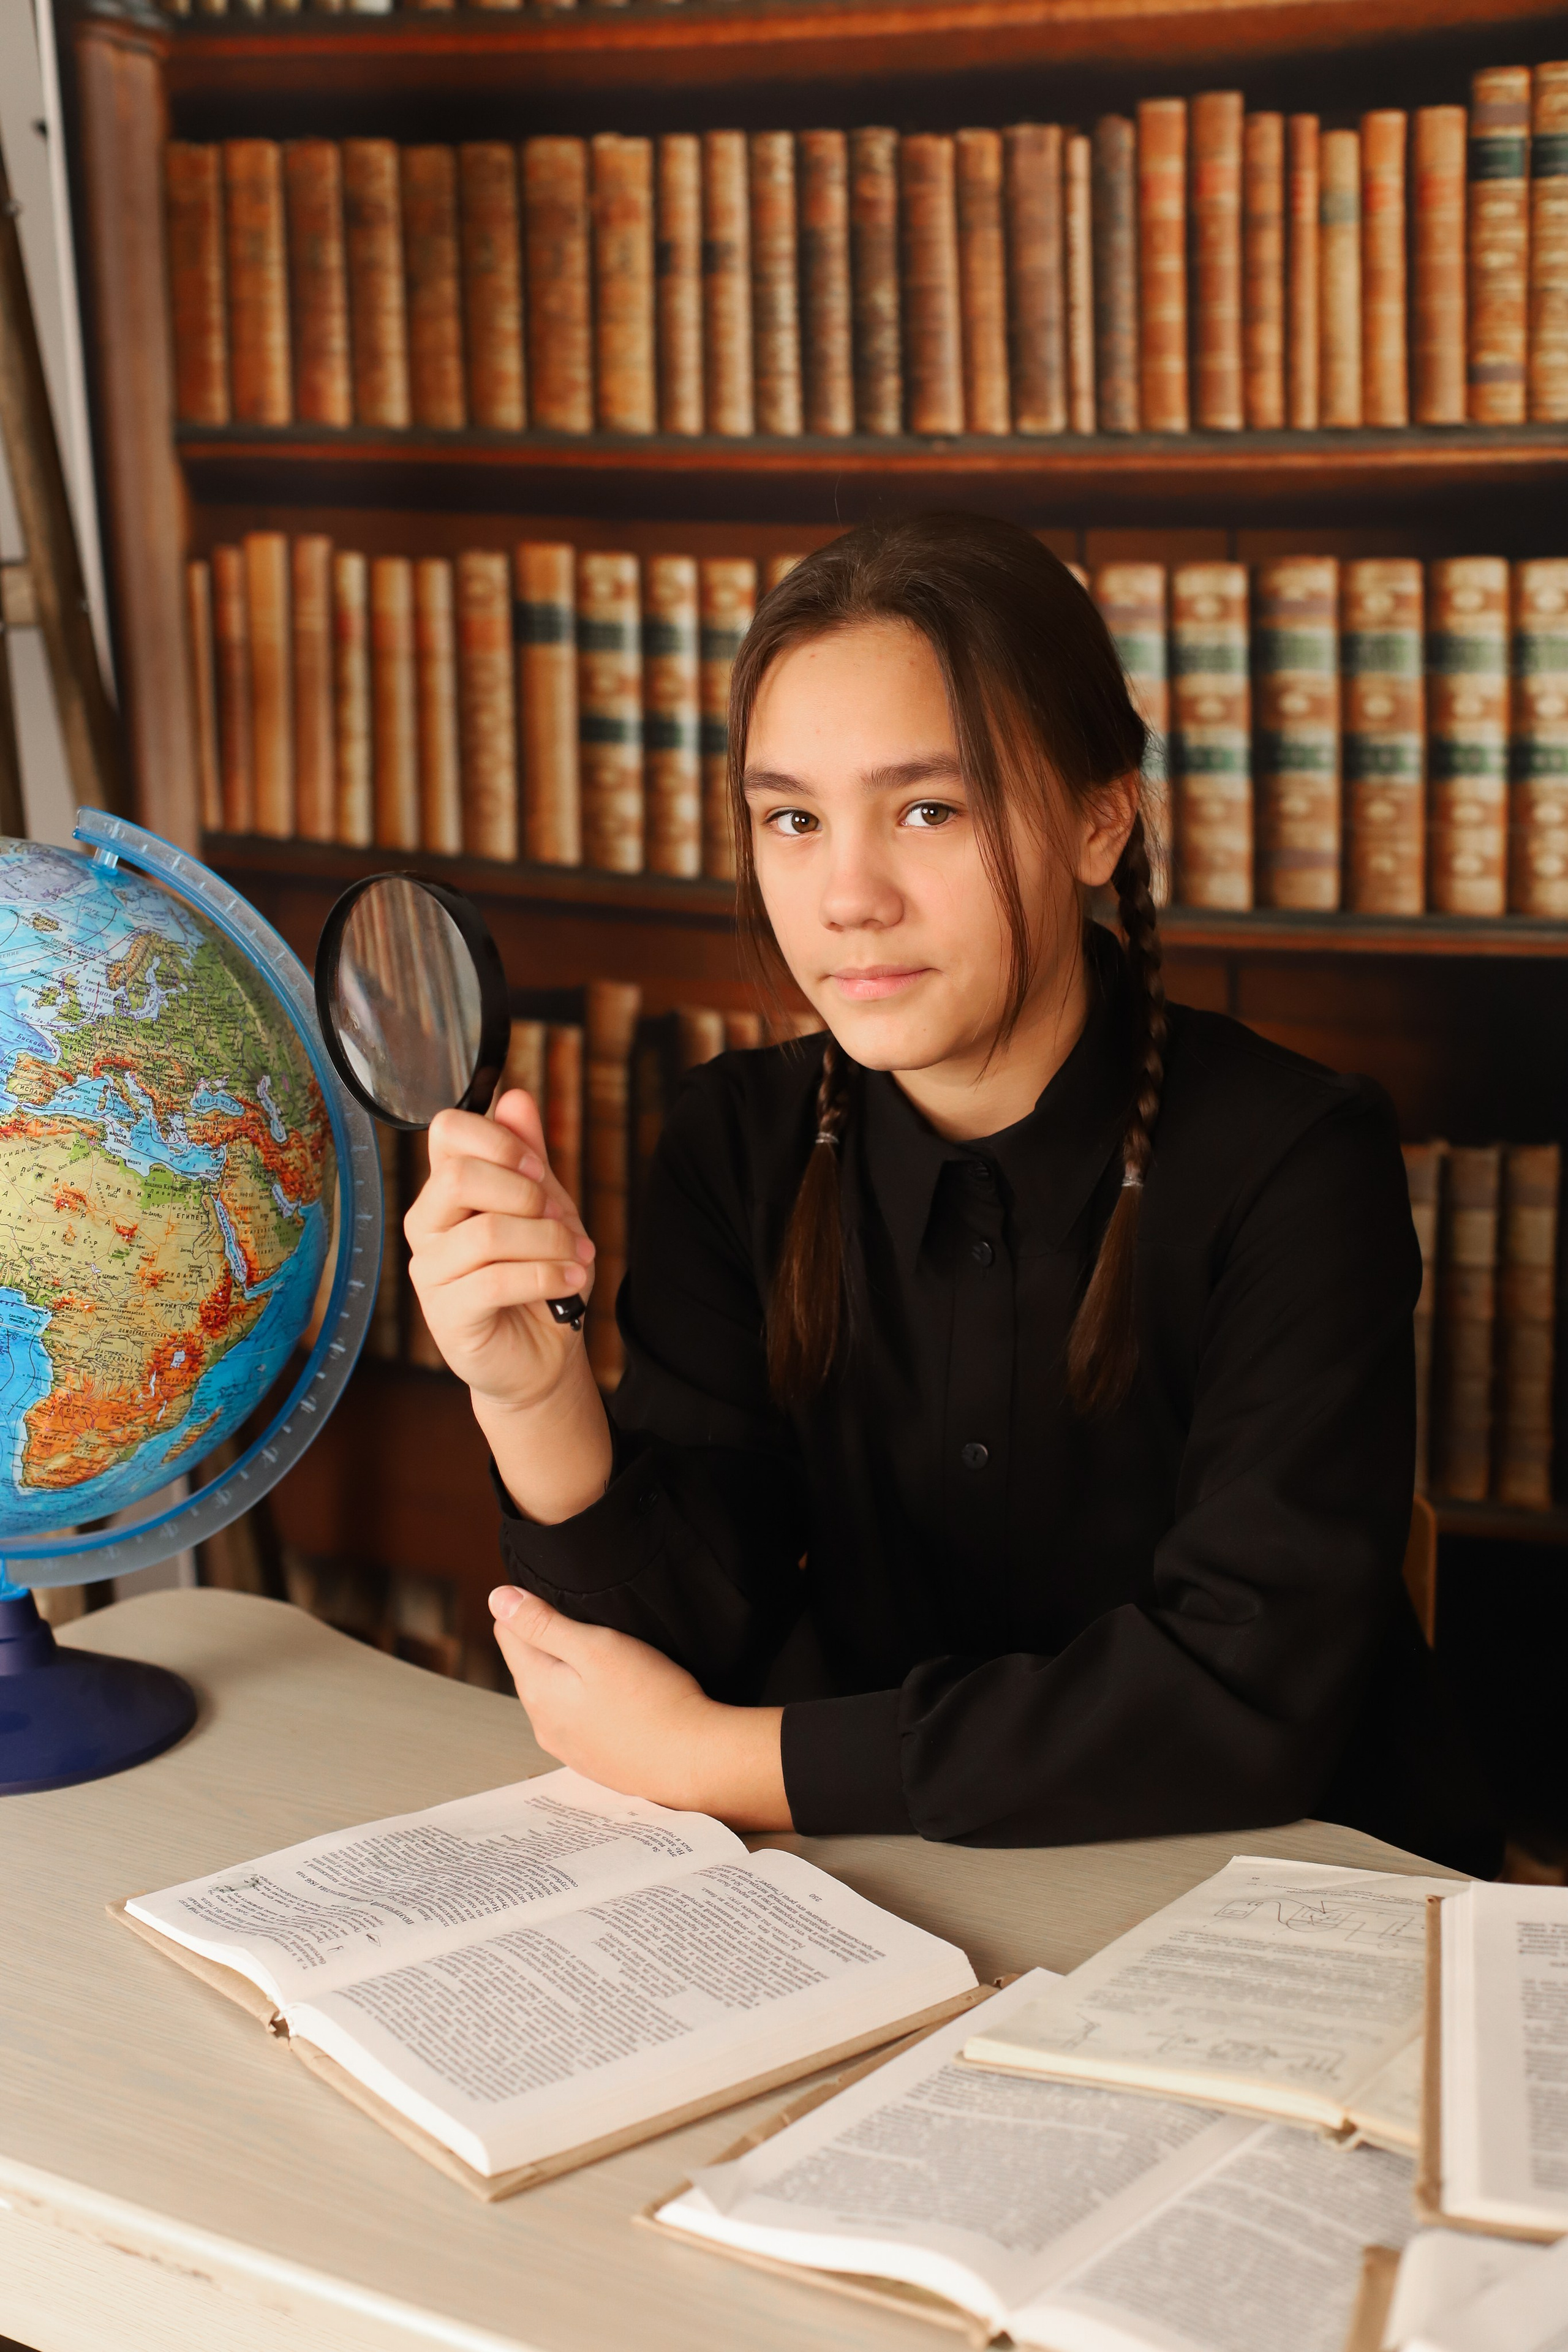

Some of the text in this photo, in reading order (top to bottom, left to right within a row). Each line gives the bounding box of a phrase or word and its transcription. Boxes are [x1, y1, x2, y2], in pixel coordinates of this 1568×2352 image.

[35, 917, 62, 932] ИСЛАНДИЯ
[80, 948, 96, 958] МОРЕ
[30, 969, 80, 990] ВЕЛИКОБРИТАНИЯ
[21, 984, 49, 998] ИРЛАНДИЯ
[80, 985, 111, 998] СЕВЕРНОЕ
[86, 1001, 103, 1010] МОРЕ
[107, 1028, 132, 1037] ГЕРМАНИЯ
[17, 1033, 58, 1053] Бискайский
[27, 1046, 43, 1054] залив
[65, 1044, 95, 1057] ФРАНЦИЯ
[20, 1085, 51, 1100] ИСПАНИЯ
[23, 1095, 48, 1107] ГИБРАЛТАР
[221, 1100, 236, 1109] МОРЕ
[1, 1121, 27, 1132] МАРОККО
[104, 1157, 120, 1166] ТРИПОЛИ
[106, 1185, 151, 1199] ЛИВИЯ
[118, 1328, 166, 1338] ДЕМОКРАТИЧЕСКАЯ
[34, 1432, 66, 1442] НАМИБИЯ
[659, 1835, 686, 1855] Но здесь
[679, 1841, 695, 1852] ных
[663, 1847, 679, 1857] эта,
[546, 1881, 562, 1892] лись
[548, 1872, 571, 1890] глубоко
[524, 1891, 537, 1899] тер
[728, 1885, 750, 1898] народа
[807, 1893, 823, 1901] 250
[491, 1894, 511, 1909] Этим,
[747, 1897, 769, 1910] жизнь
[760, 1896, 775, 1905] уже
[764, 1893, 798, 1913] известный
[780, 1894, 798, 1904] речи
[722, 1901, 741, 1912] почти
[462, 1909, 477, 1919] для
[700, 1907, 744, 1934] рассказанной
[732, 1919, 750, 1929] этой
